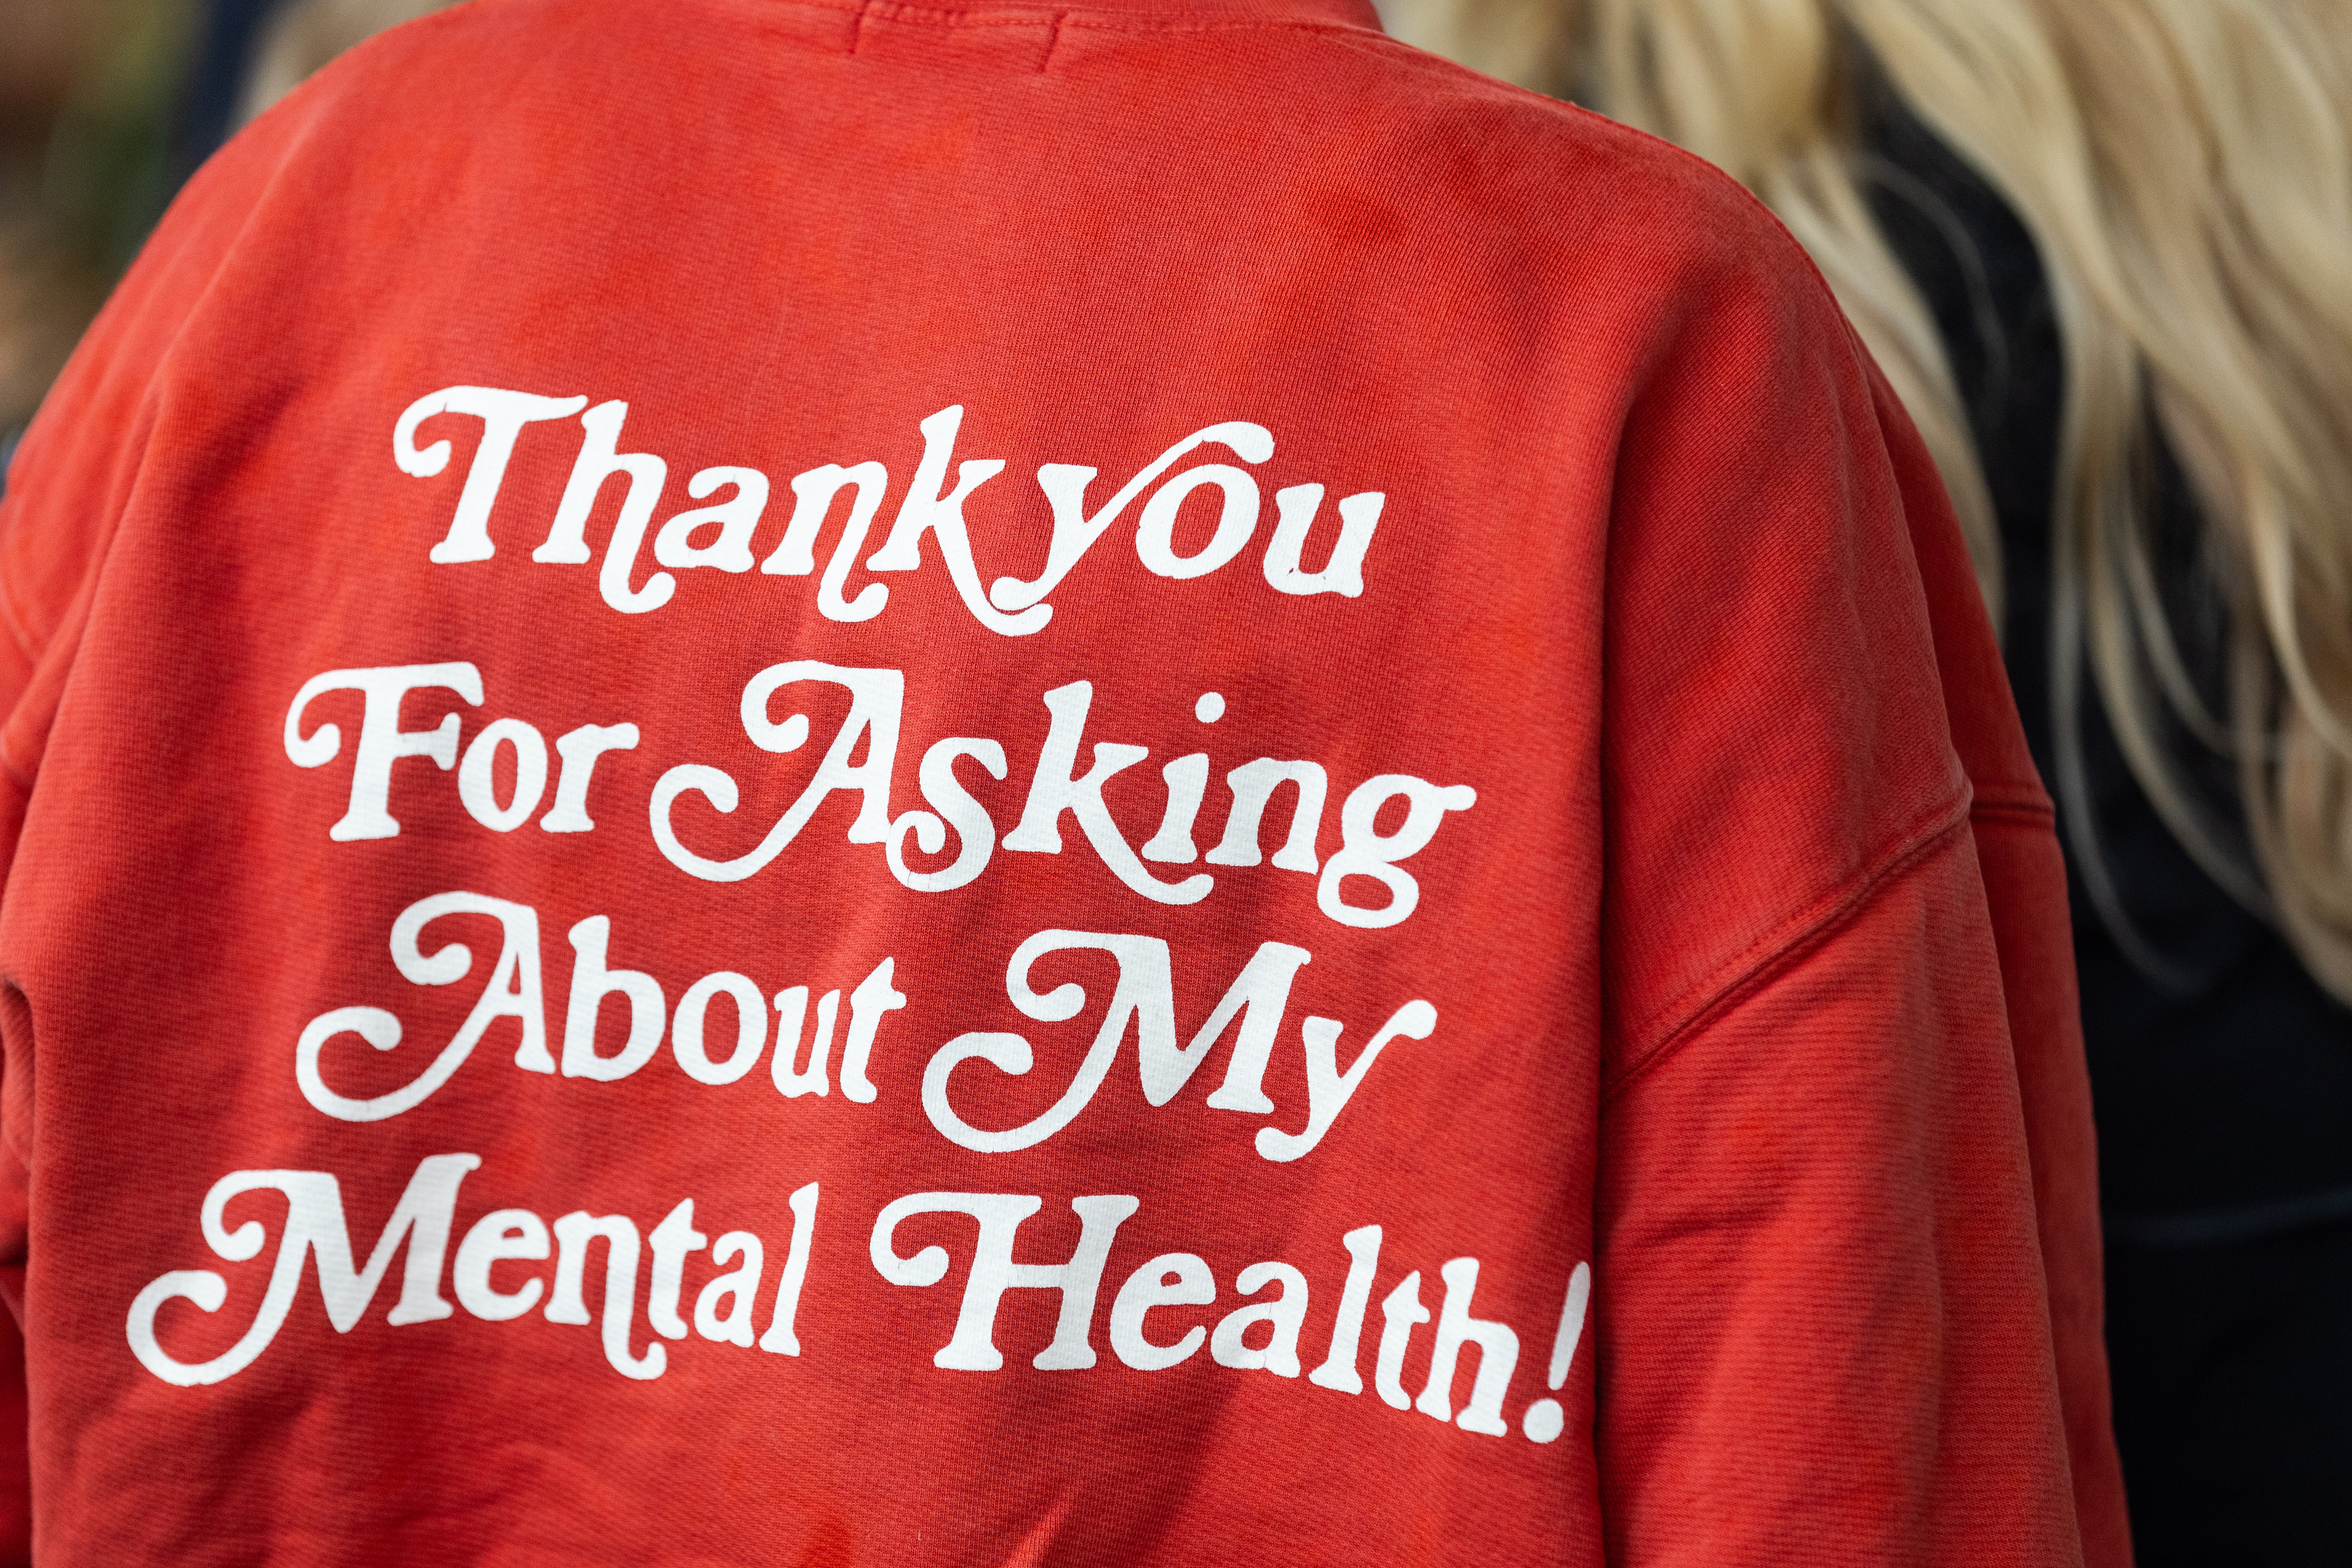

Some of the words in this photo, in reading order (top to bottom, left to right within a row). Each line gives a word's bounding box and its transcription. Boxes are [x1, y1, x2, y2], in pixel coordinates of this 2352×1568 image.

[283, 661, 641, 842] For
[648, 659, 1478, 930] Asking
[295, 890, 907, 1123] About
[920, 928, 1438, 1164] My
[125, 1152, 820, 1388] Mental
[869, 1190, 1590, 1445] Health!
